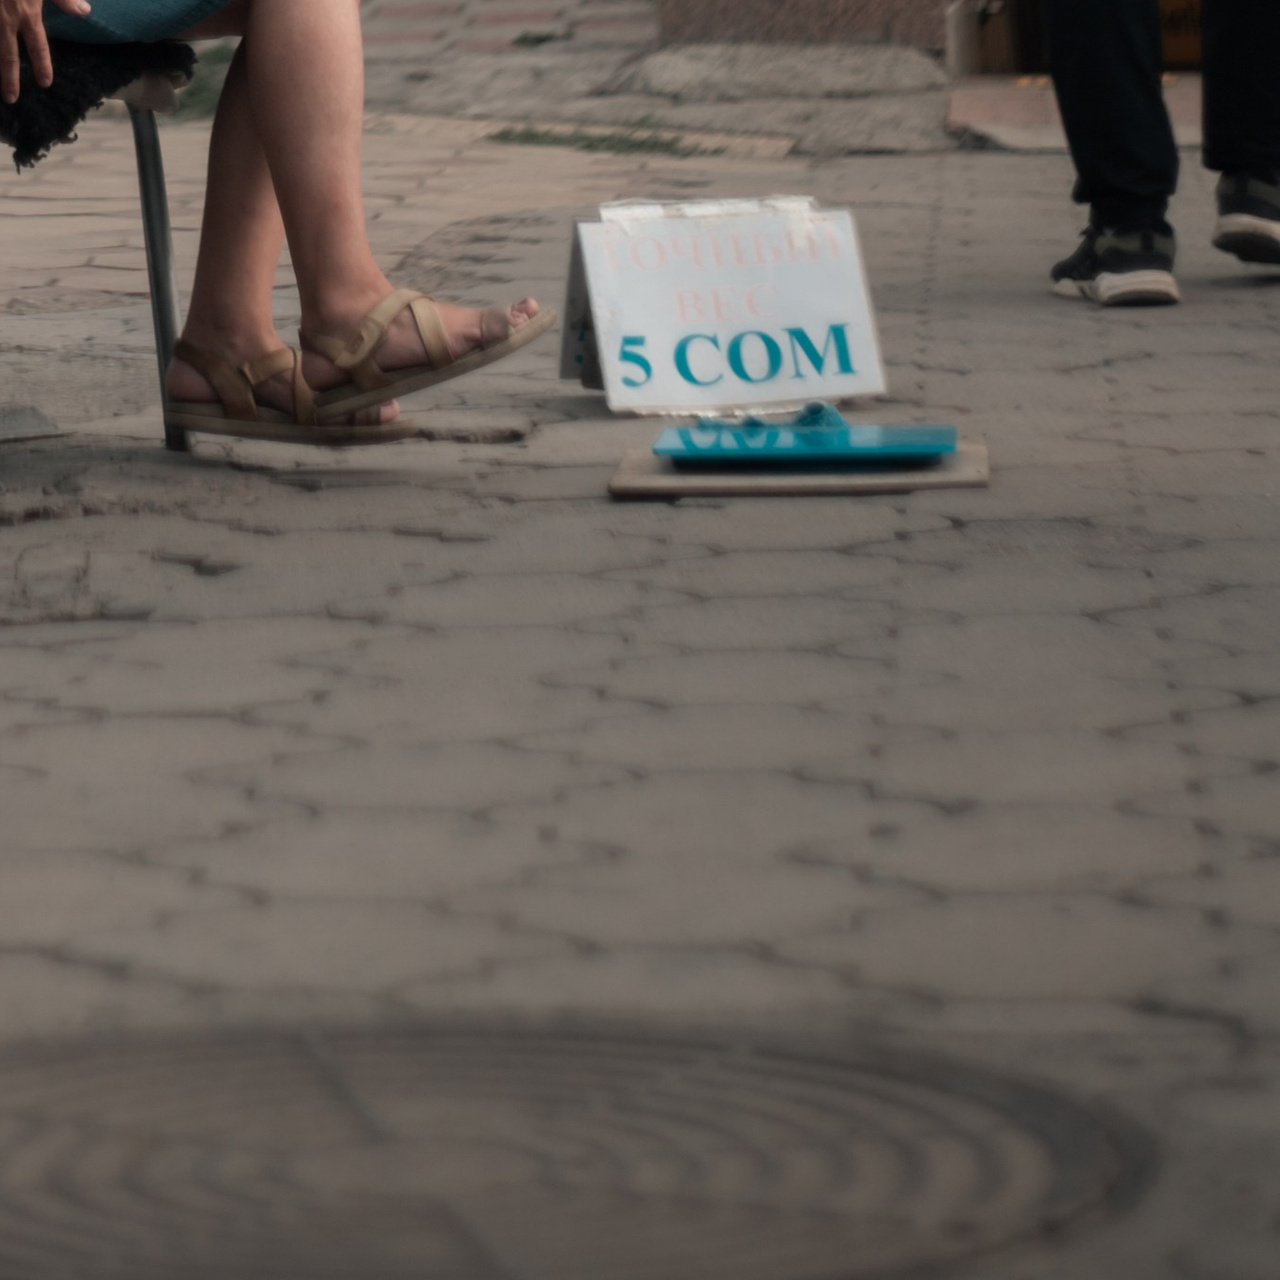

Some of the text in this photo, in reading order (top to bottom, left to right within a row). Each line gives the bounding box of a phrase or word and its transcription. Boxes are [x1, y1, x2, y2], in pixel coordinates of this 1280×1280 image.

[675, 284, 780, 324] ВЕС
[618, 323, 858, 388] 5 СОМ
